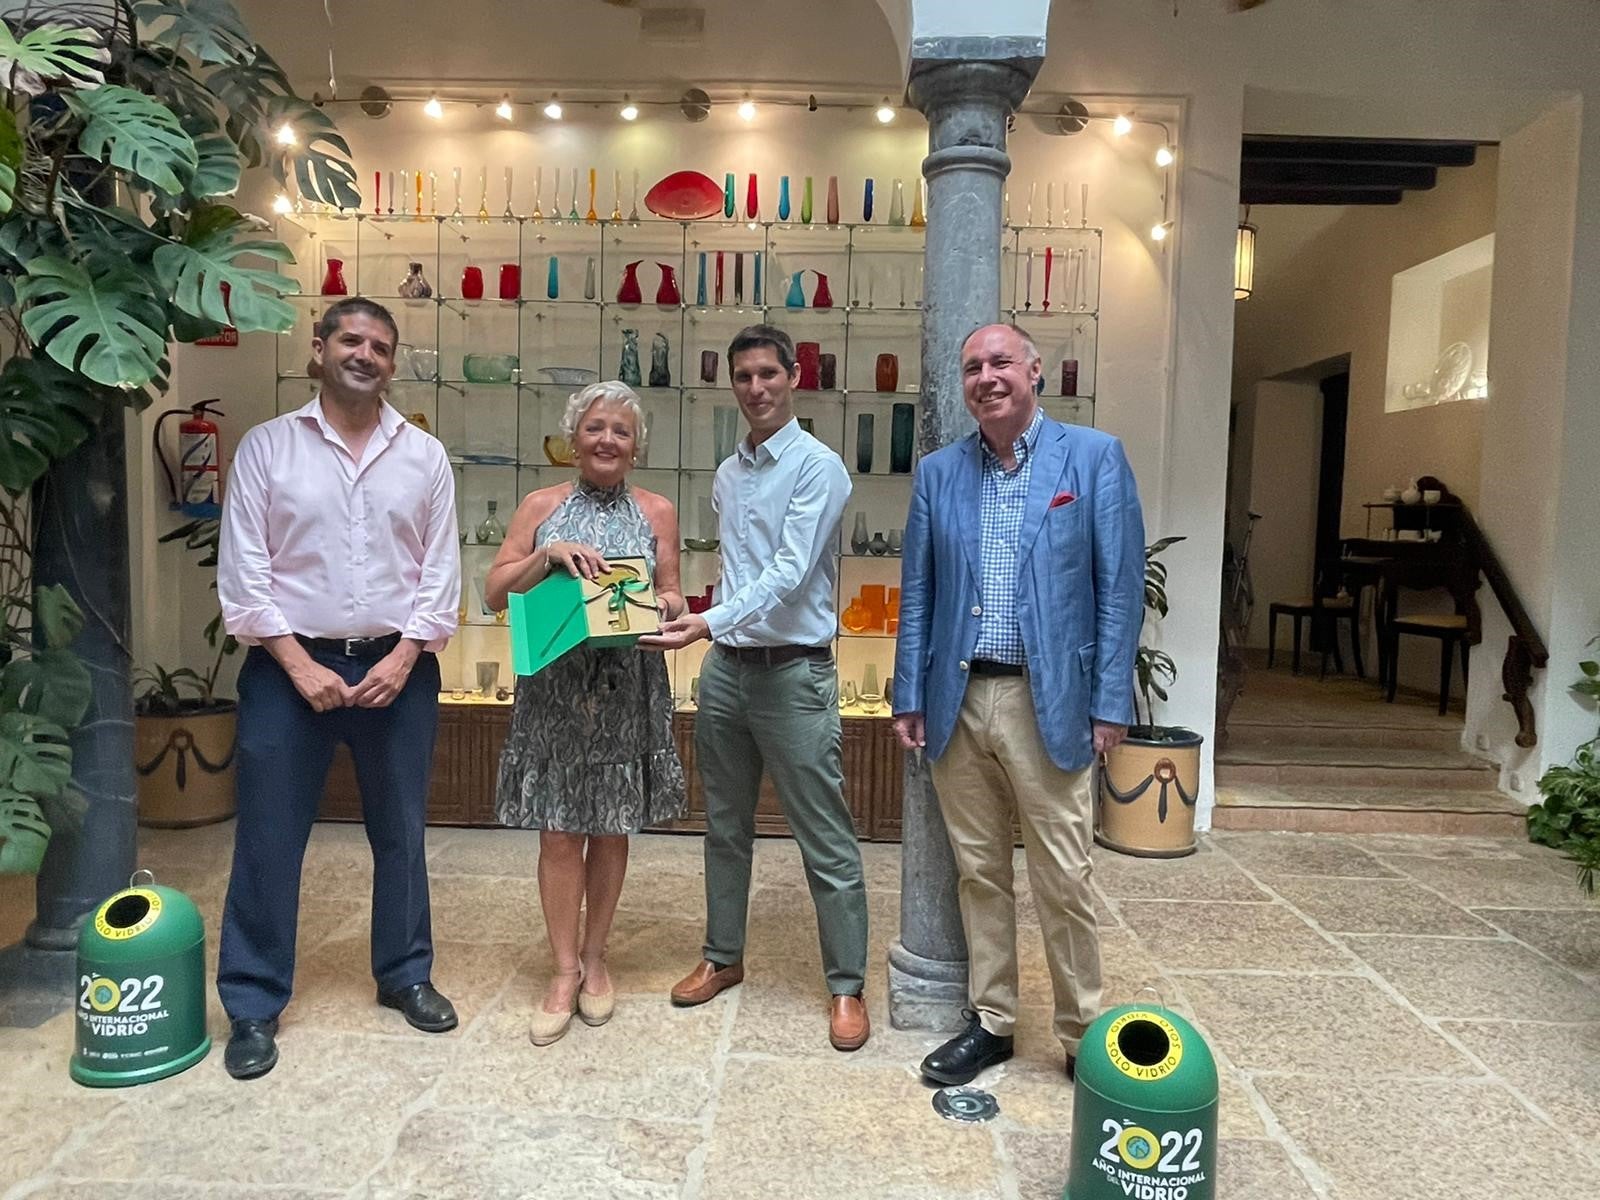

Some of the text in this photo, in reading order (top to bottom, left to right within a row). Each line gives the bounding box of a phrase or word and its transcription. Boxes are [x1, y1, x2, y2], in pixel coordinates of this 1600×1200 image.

[80, 974, 164, 1013] 2022
[89, 1010, 169, 1024] INTERNACIONAL
[91, 1022, 148, 1037] VIDRIO
[1108, 1041, 1177, 1078] SOLO VIDRIO
[1100, 1118, 1203, 1173] 2022
[1092, 1157, 1206, 1187] AÑO INTERNACIONAL
[1120, 1179, 1188, 1200] VIDRIO
